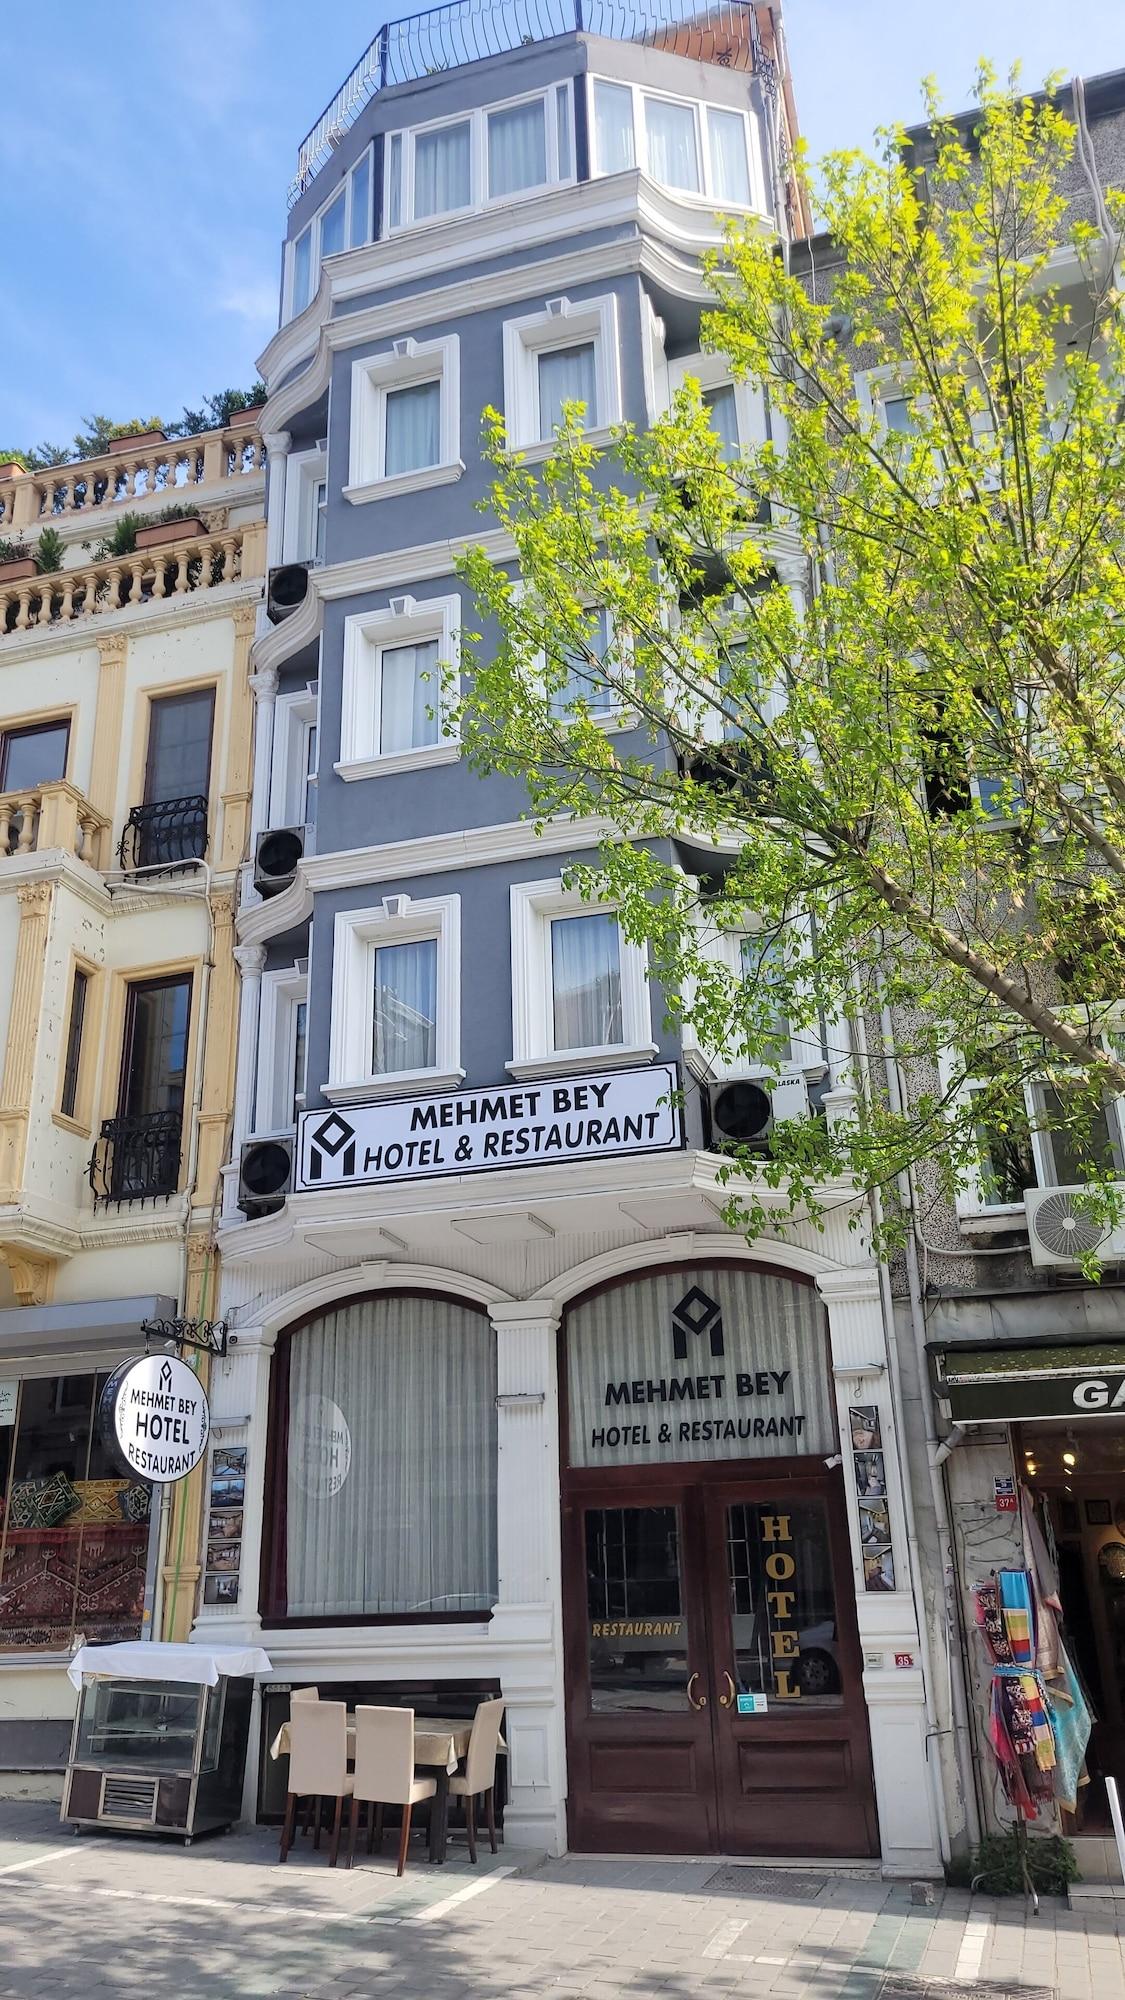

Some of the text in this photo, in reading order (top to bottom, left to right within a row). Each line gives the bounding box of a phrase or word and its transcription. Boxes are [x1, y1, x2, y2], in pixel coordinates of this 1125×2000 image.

[410, 1082, 612, 1131] MEHMET BEY
[363, 1112, 660, 1173] HOTEL & RESTAURANT
[130, 1388, 197, 1416] MEHMET BEY
[604, 1370, 791, 1406] MEHMET BEY
[136, 1411, 190, 1445] HOTEL
[592, 1415, 806, 1448] HOTEL & RESTAURANT
[128, 1442, 196, 1474] RESTAURANT
[760, 1515, 800, 1698] HOTEL
[592, 1622, 681, 1638] RESTAURANT
[897, 1655, 910, 1666] 35
